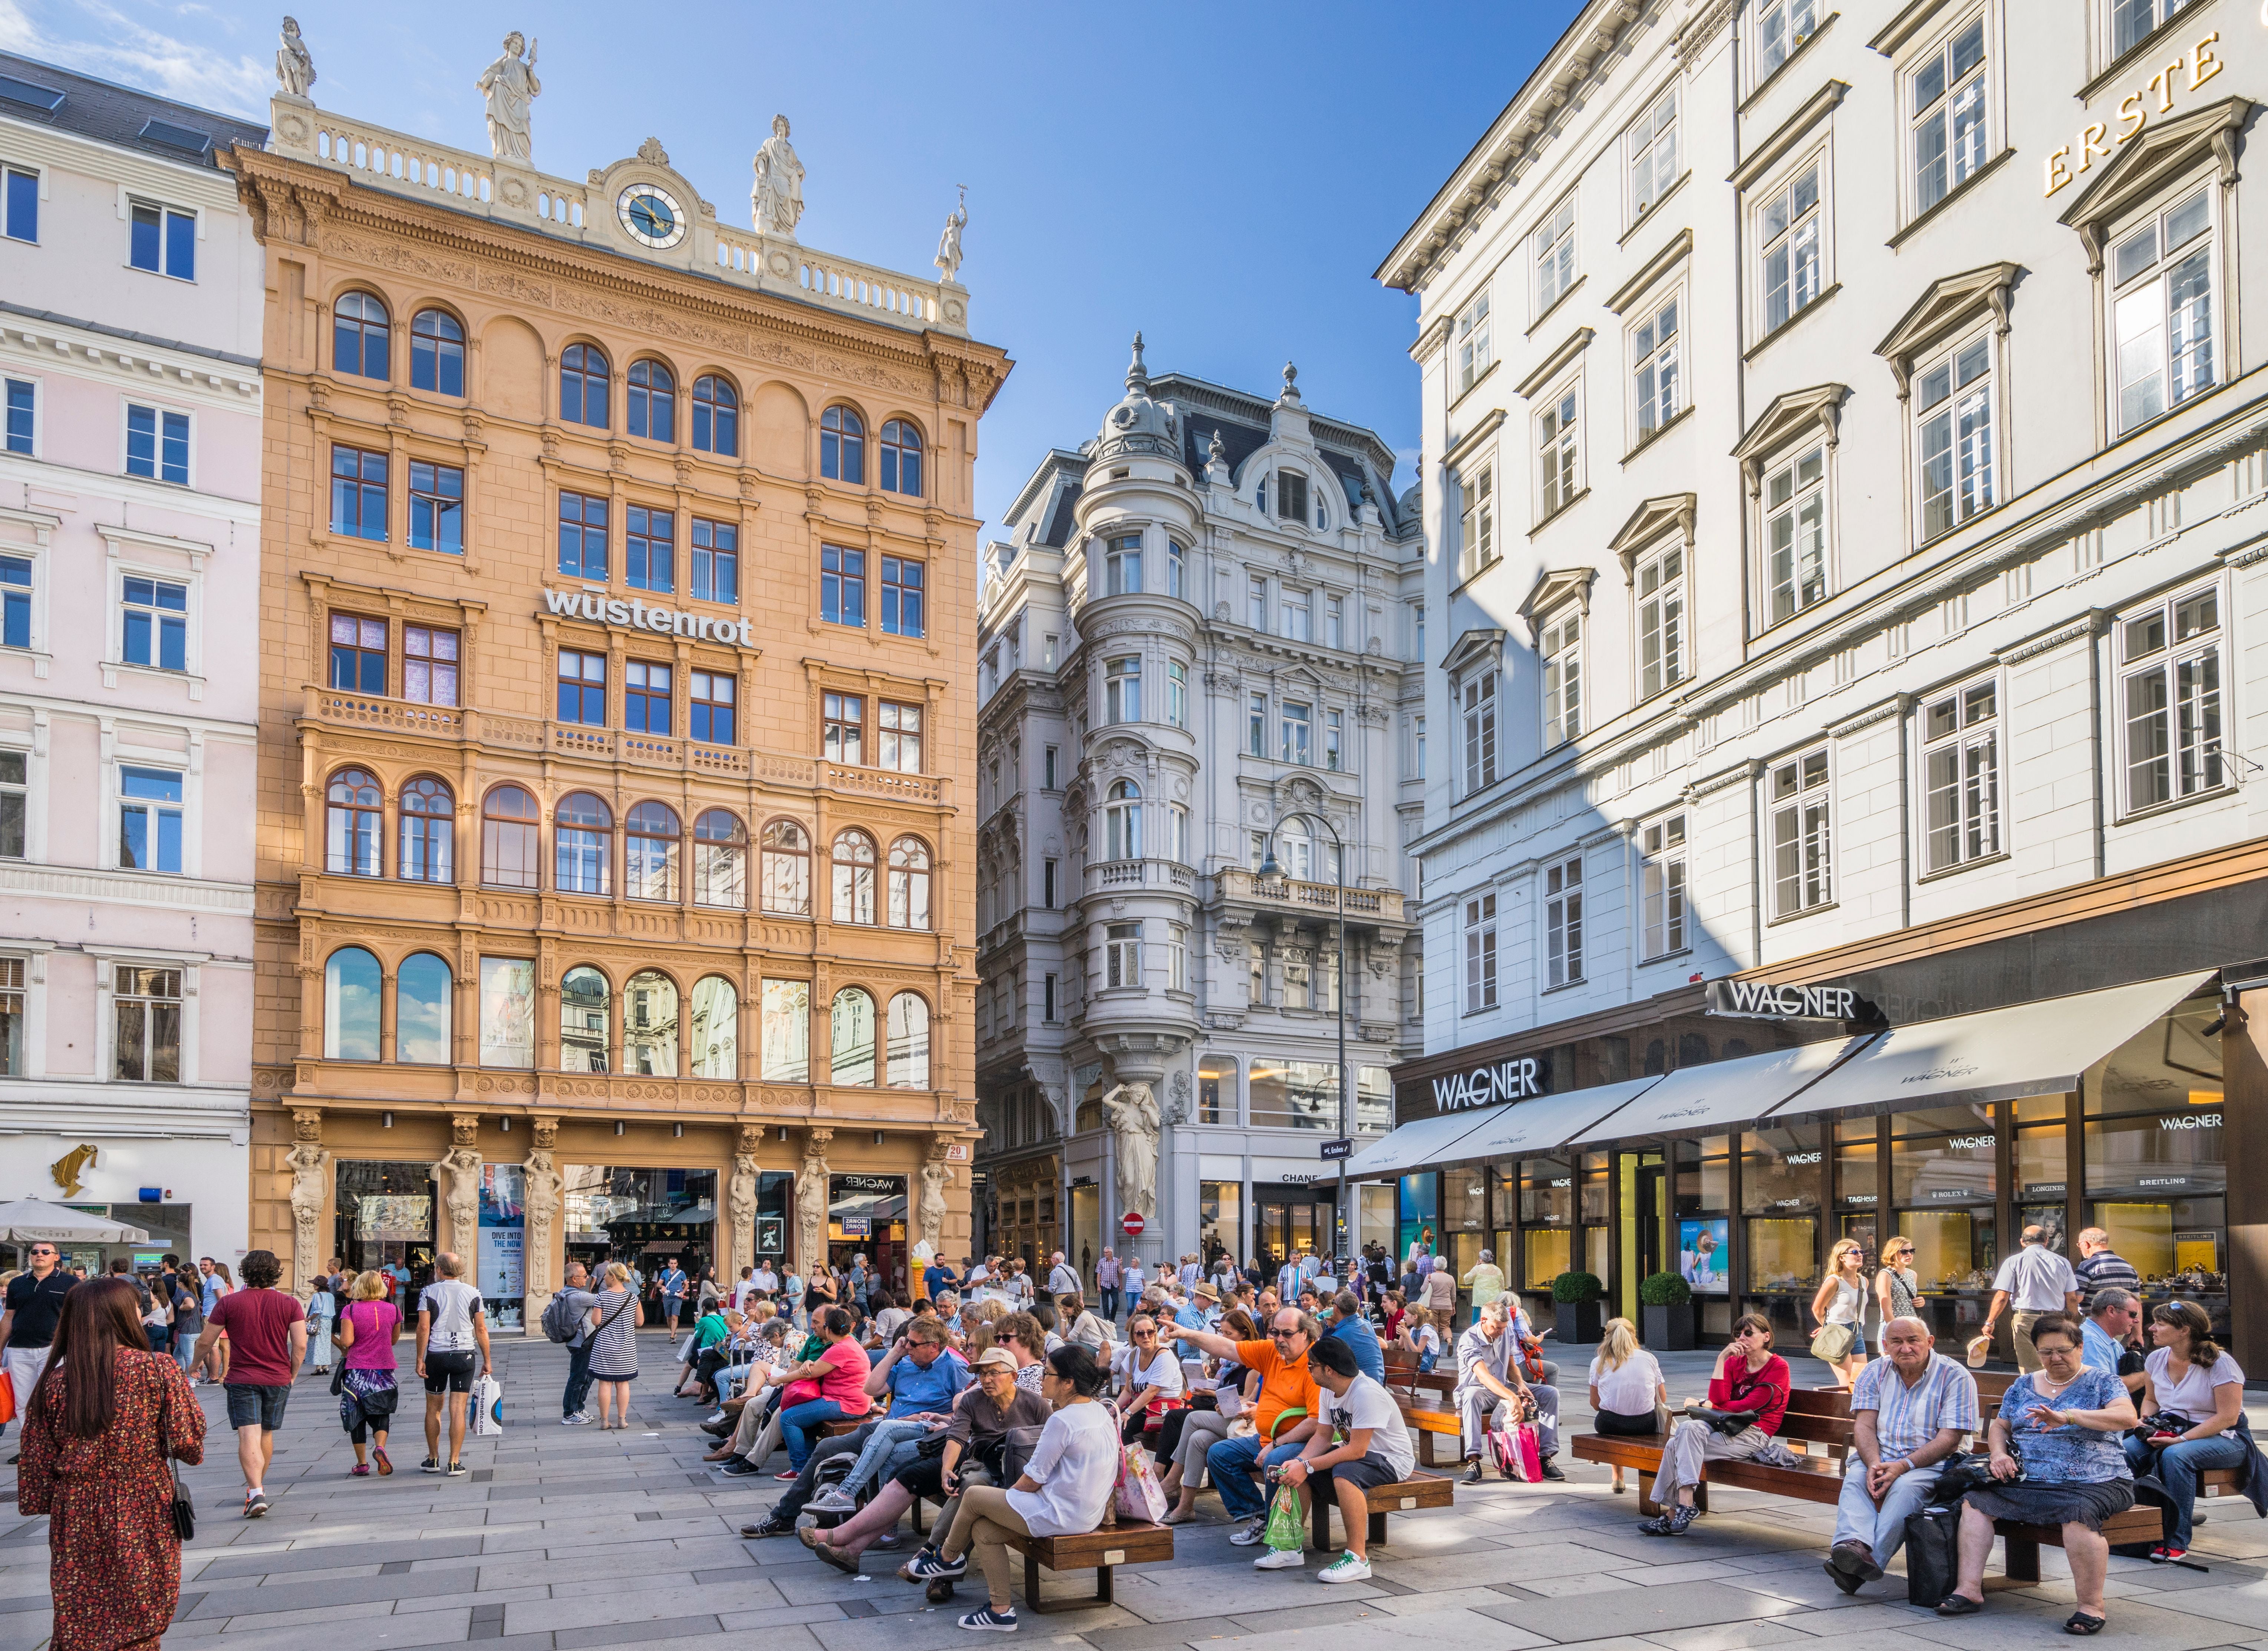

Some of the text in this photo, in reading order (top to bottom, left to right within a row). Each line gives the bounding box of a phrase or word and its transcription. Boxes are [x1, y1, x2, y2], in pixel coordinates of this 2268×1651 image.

[2044, 31, 2223, 198] ERSTE
[1728, 979, 1855, 1018] WAGNER
[1901, 1067, 1978, 1084] WAGNER
[1433, 1058, 1537, 1112] WAGNER
[1657, 1108, 1710, 1120] WAGNER
[2159, 1114, 2222, 1130] WAGNER
[1949, 1136, 1995, 1149] WAGNER
[950, 1146, 960, 1154] 20
[1073, 1176, 1091, 1185] CHANEL
[1551, 1178, 1571, 1187] WAGNE
[1468, 1187, 1484, 1195] WAGNE
[1938, 1187, 1961, 1197] ROLEX
[508, 1261, 518, 1292] MOËT
[475, 1383, 486, 1434] blue-tomato.com
[1273, 1519, 1301, 1529] PIRKR
